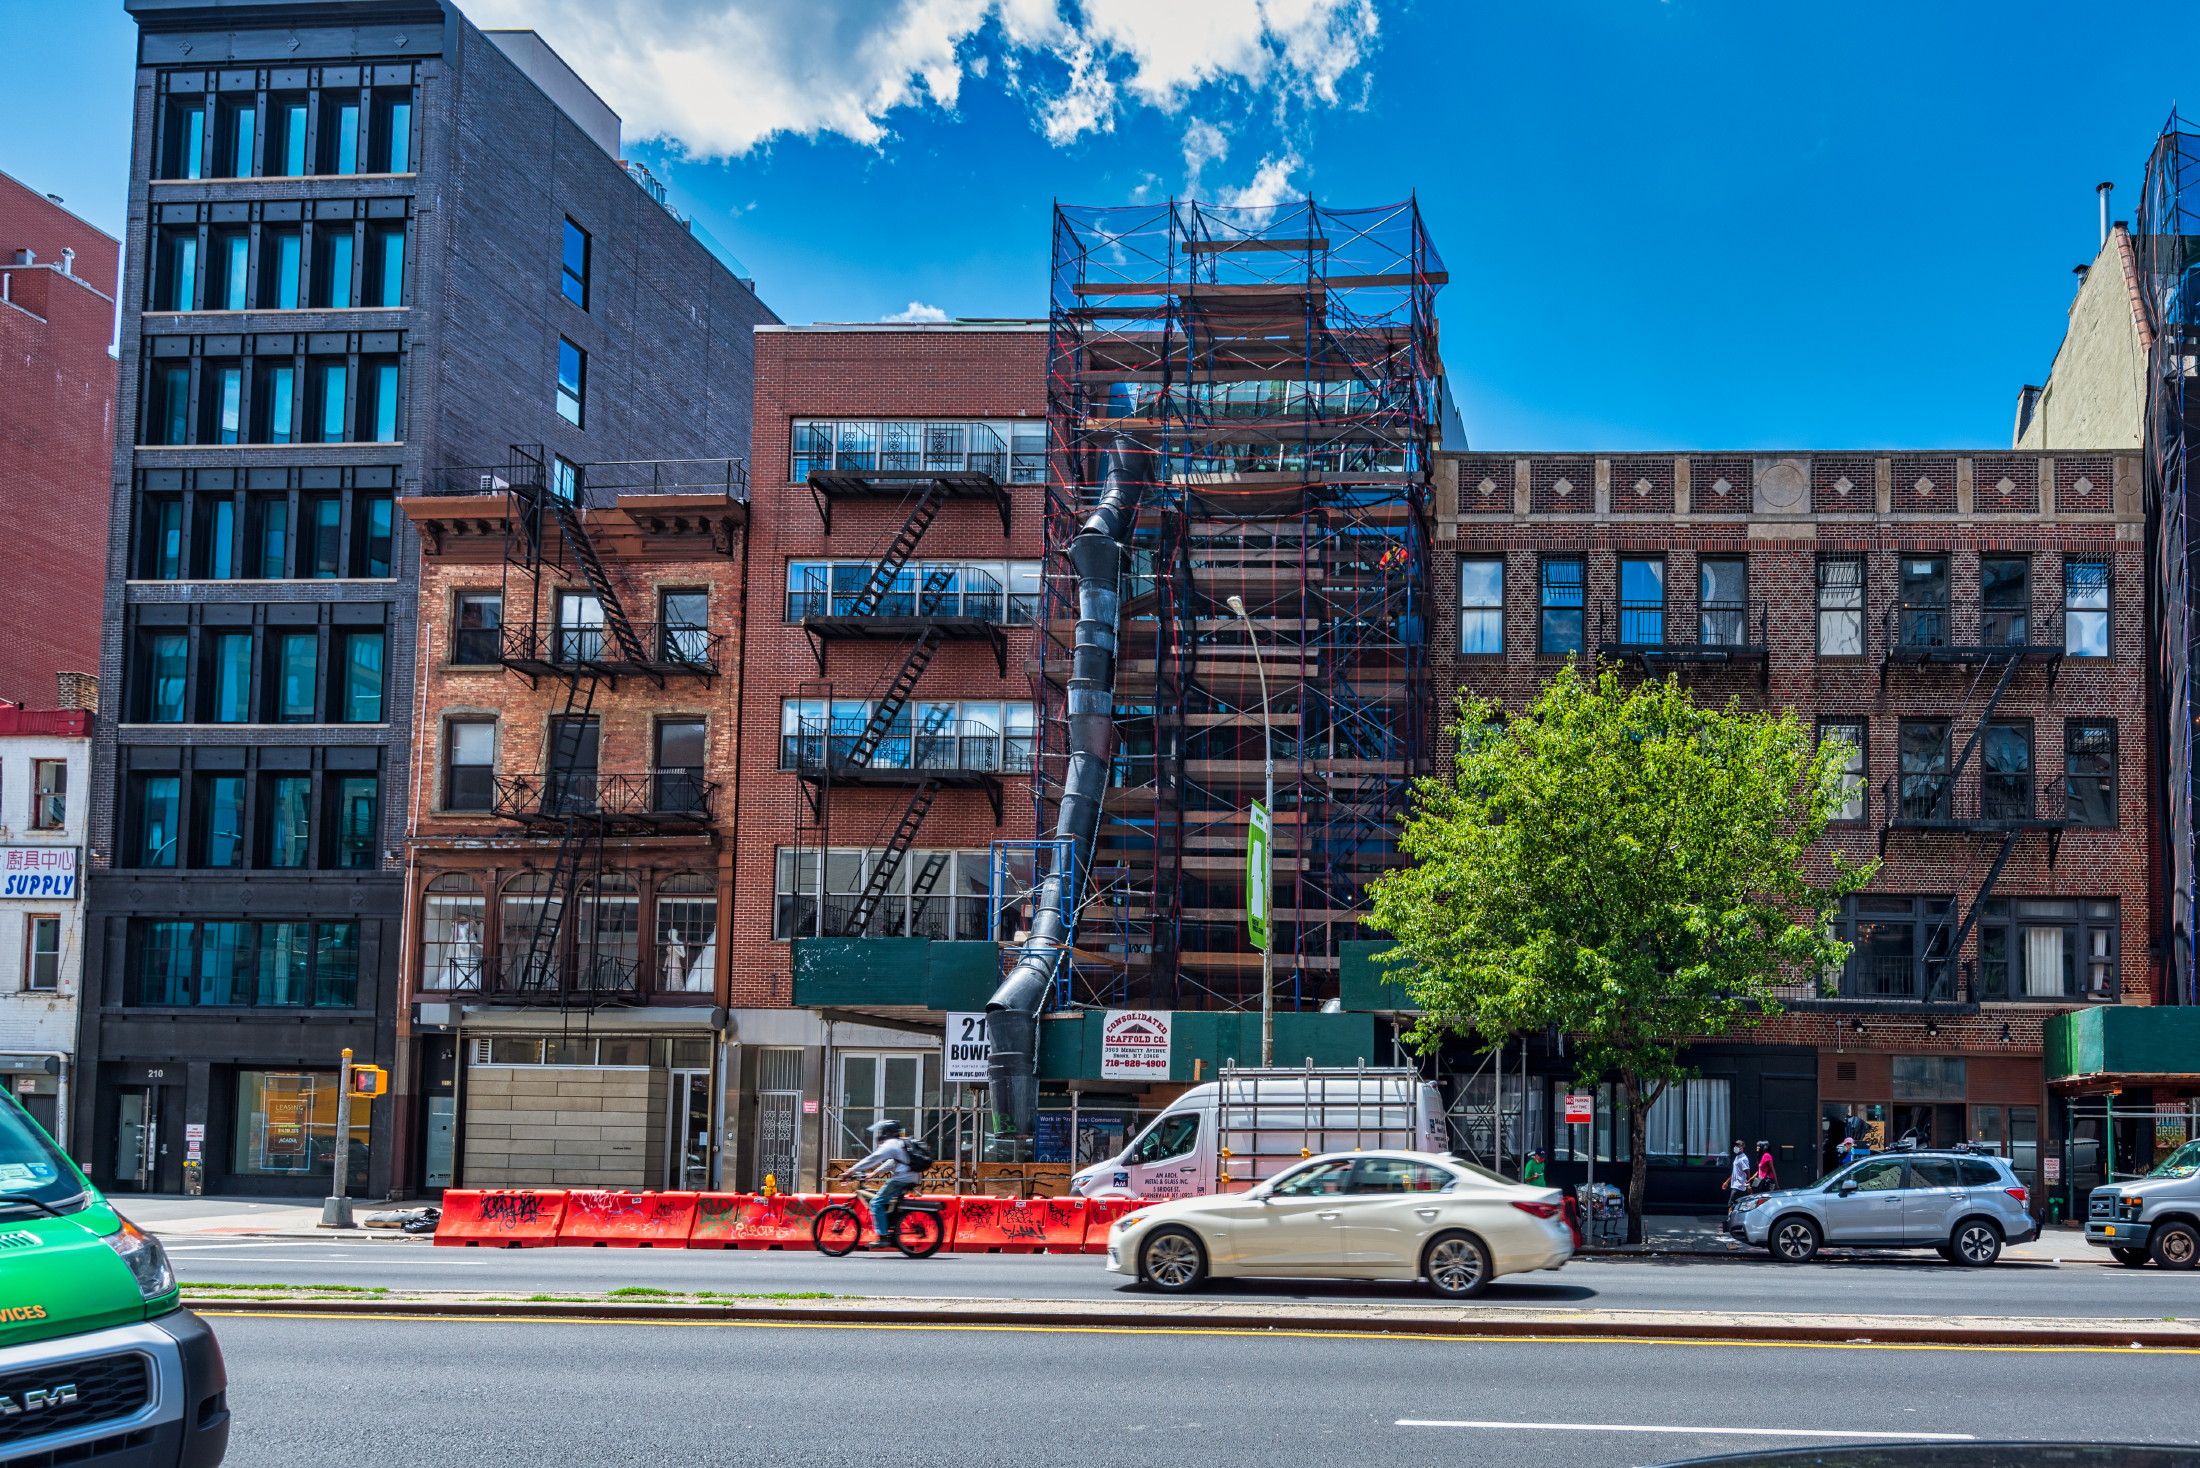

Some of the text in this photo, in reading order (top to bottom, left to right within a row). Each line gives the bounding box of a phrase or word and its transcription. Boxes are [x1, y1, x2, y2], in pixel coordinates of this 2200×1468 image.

[6, 850, 75, 871] 廚具中心
[5, 875, 74, 895] SUPPLY
[961, 1017, 990, 1042] 21
[1106, 1013, 1168, 1035] CONSOLIDATED
[148, 1070, 164, 1078] 210
[2156, 1126, 2186, 1136] ORDER
